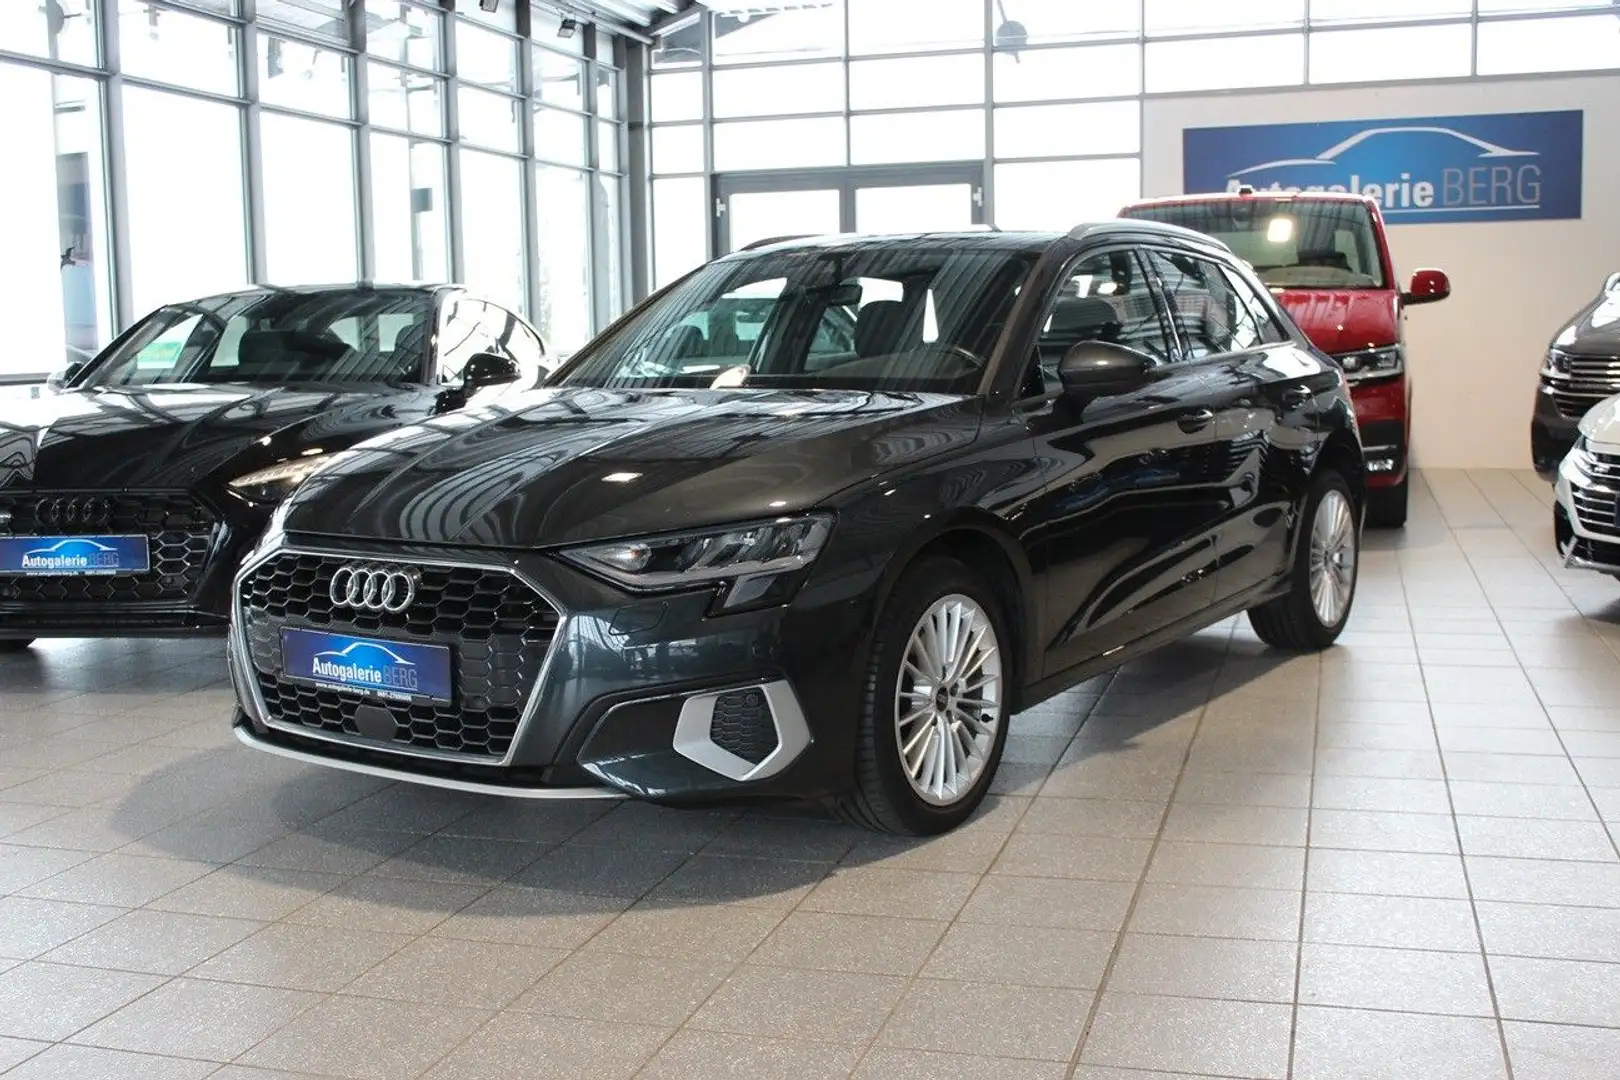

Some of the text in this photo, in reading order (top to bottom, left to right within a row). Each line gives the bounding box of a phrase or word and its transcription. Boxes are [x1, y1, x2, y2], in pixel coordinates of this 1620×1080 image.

[1441, 164, 1541, 206] BERG
[22, 554, 88, 568] Autogalerie
[312, 657, 418, 689] Autogalerie BERG
